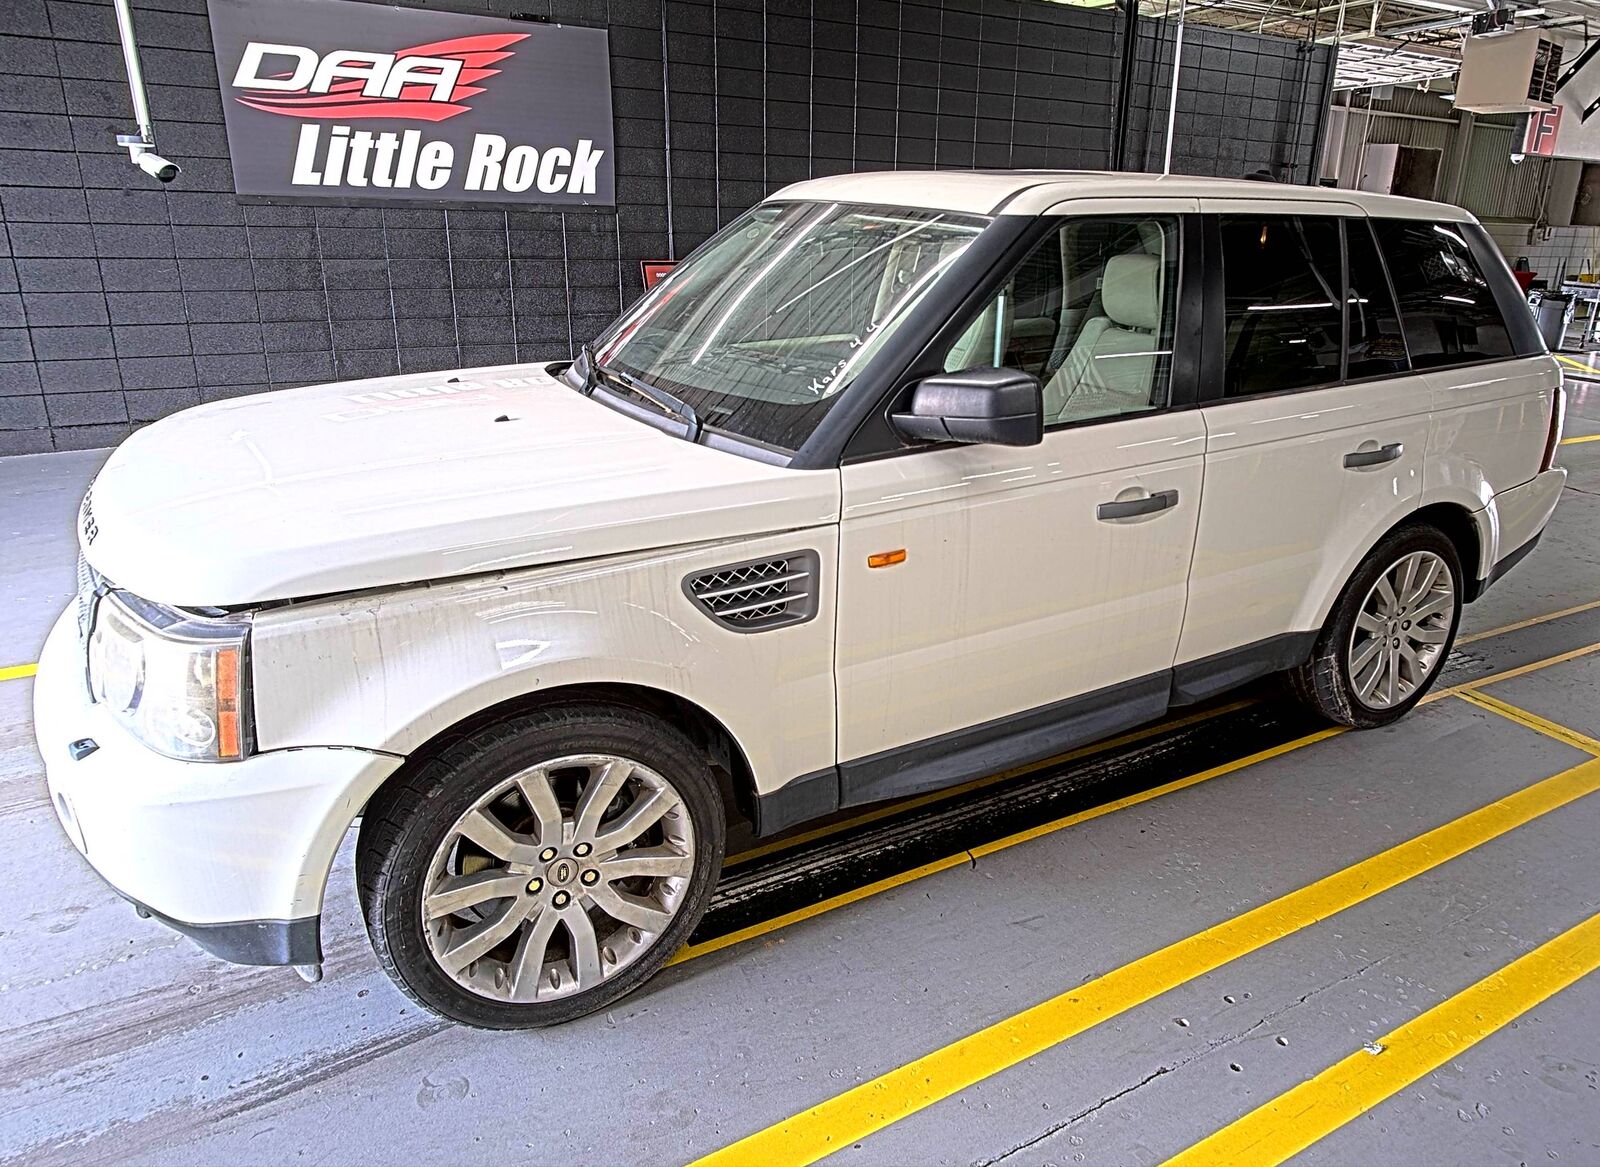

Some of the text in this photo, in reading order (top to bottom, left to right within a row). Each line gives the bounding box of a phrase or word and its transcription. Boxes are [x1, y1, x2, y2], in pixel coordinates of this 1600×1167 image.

[231, 41, 465, 102] DAA
[291, 123, 605, 195] Little Rock
[807, 358, 848, 395] Kars
